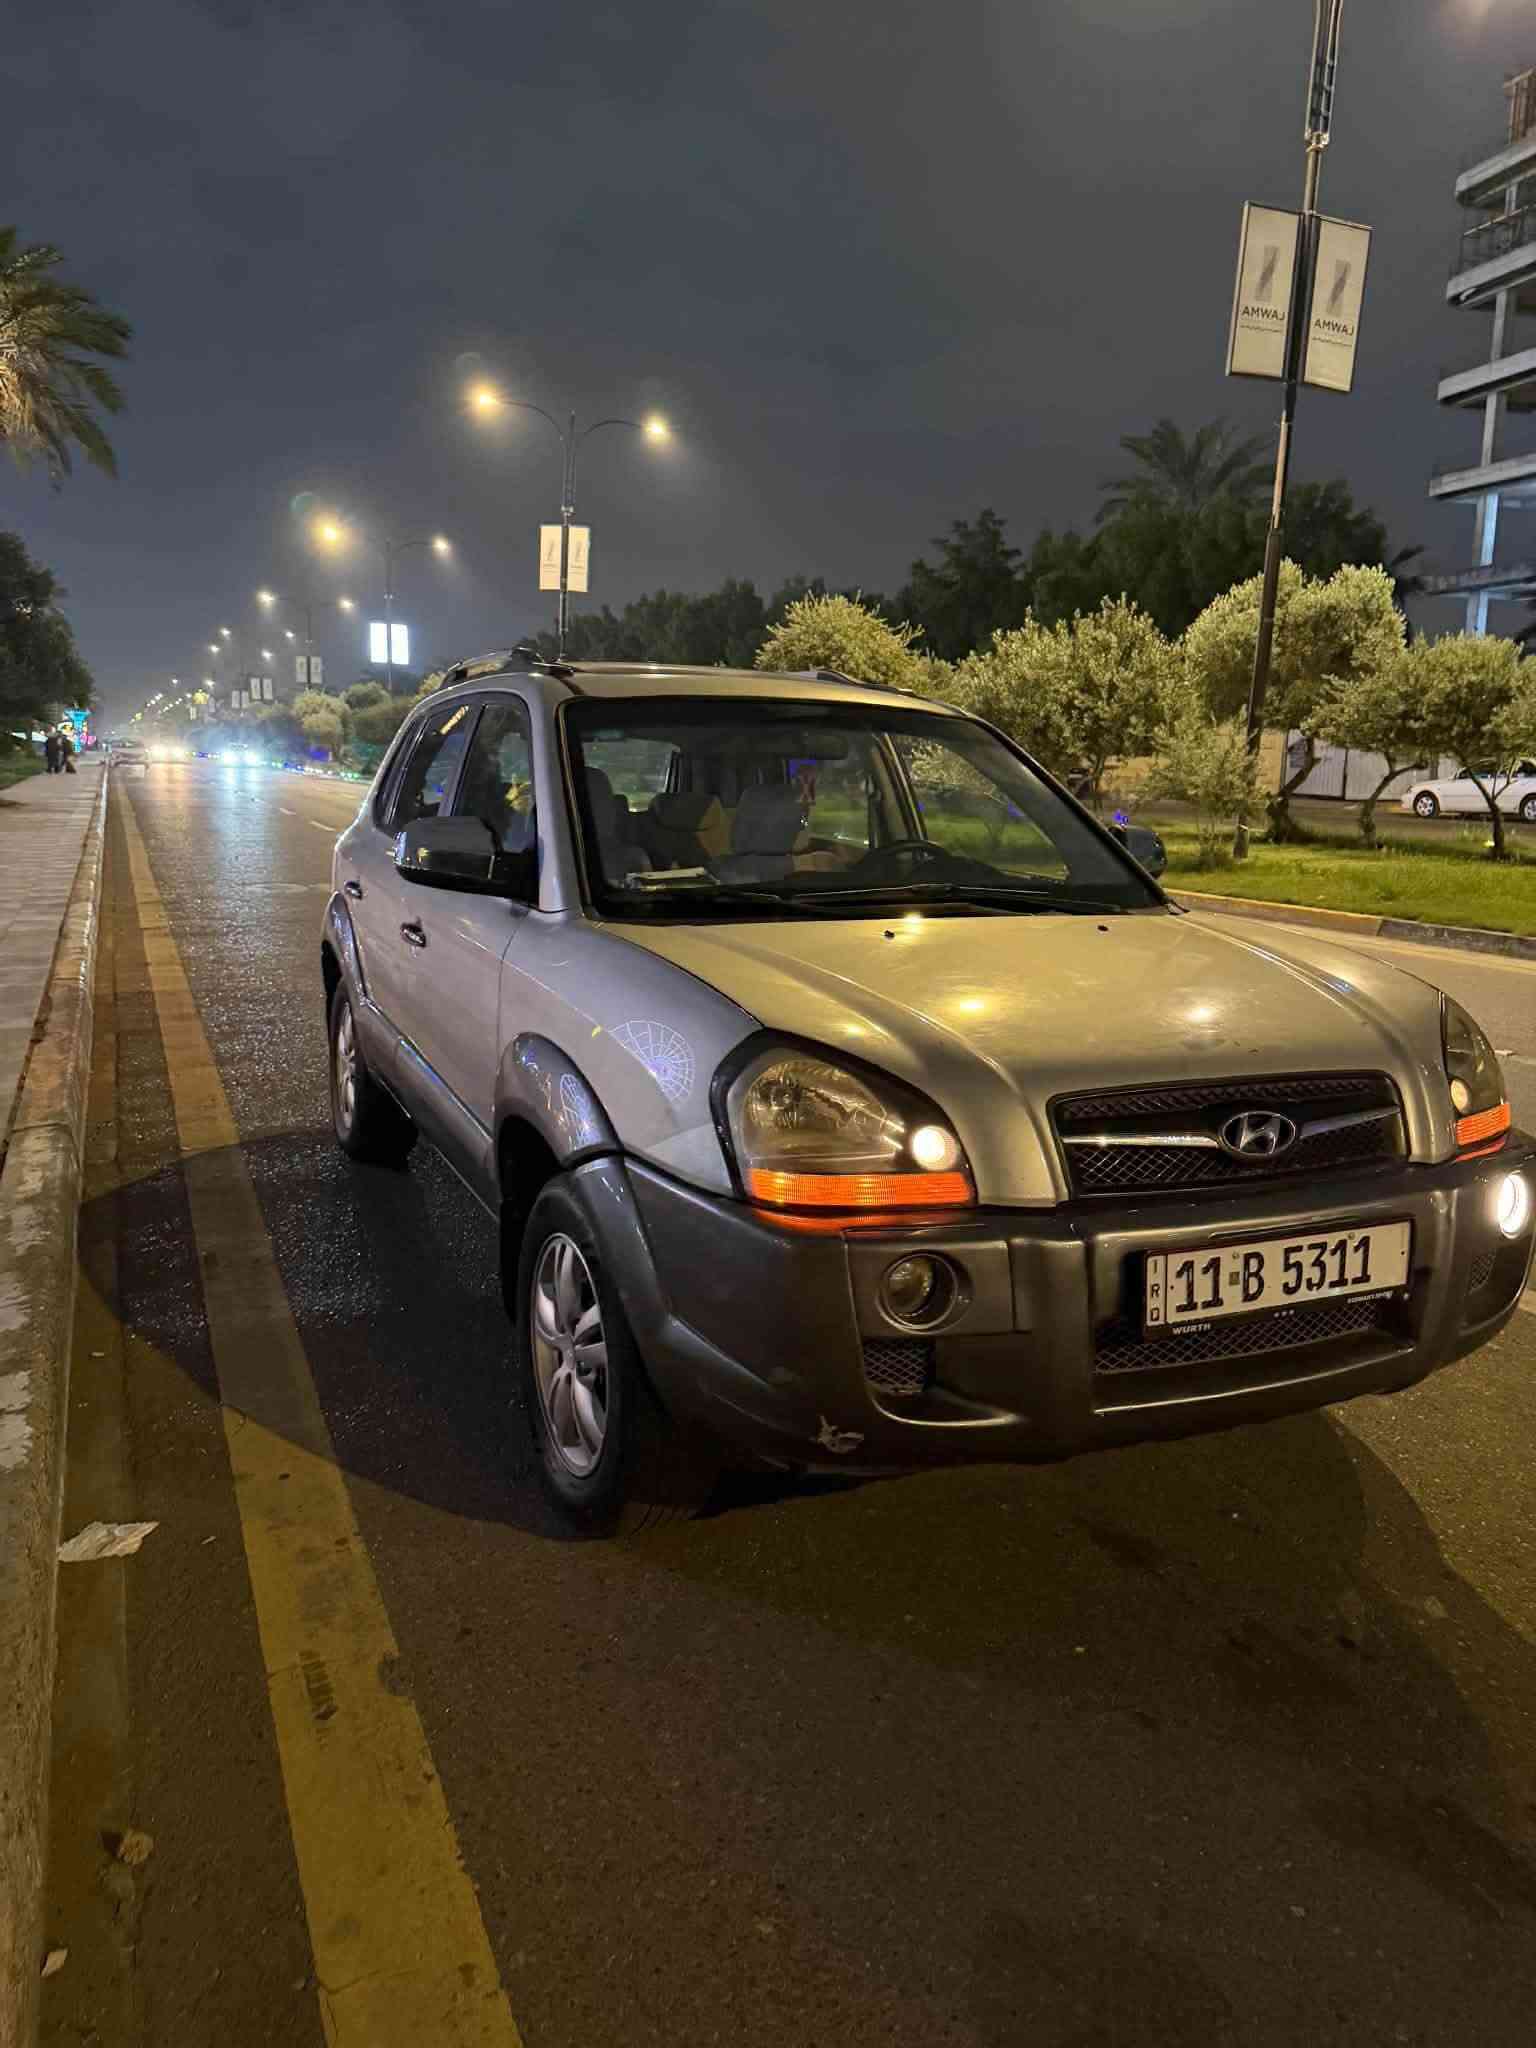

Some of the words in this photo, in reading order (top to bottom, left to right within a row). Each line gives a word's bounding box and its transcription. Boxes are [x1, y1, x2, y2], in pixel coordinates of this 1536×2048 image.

[1241, 306, 1286, 321] AMWAJ
[1313, 318, 1355, 336] AMWAJ
[1174, 1256, 1224, 1313] 11
[1241, 1251, 1265, 1303] B
[1282, 1235, 1372, 1295] 5311
